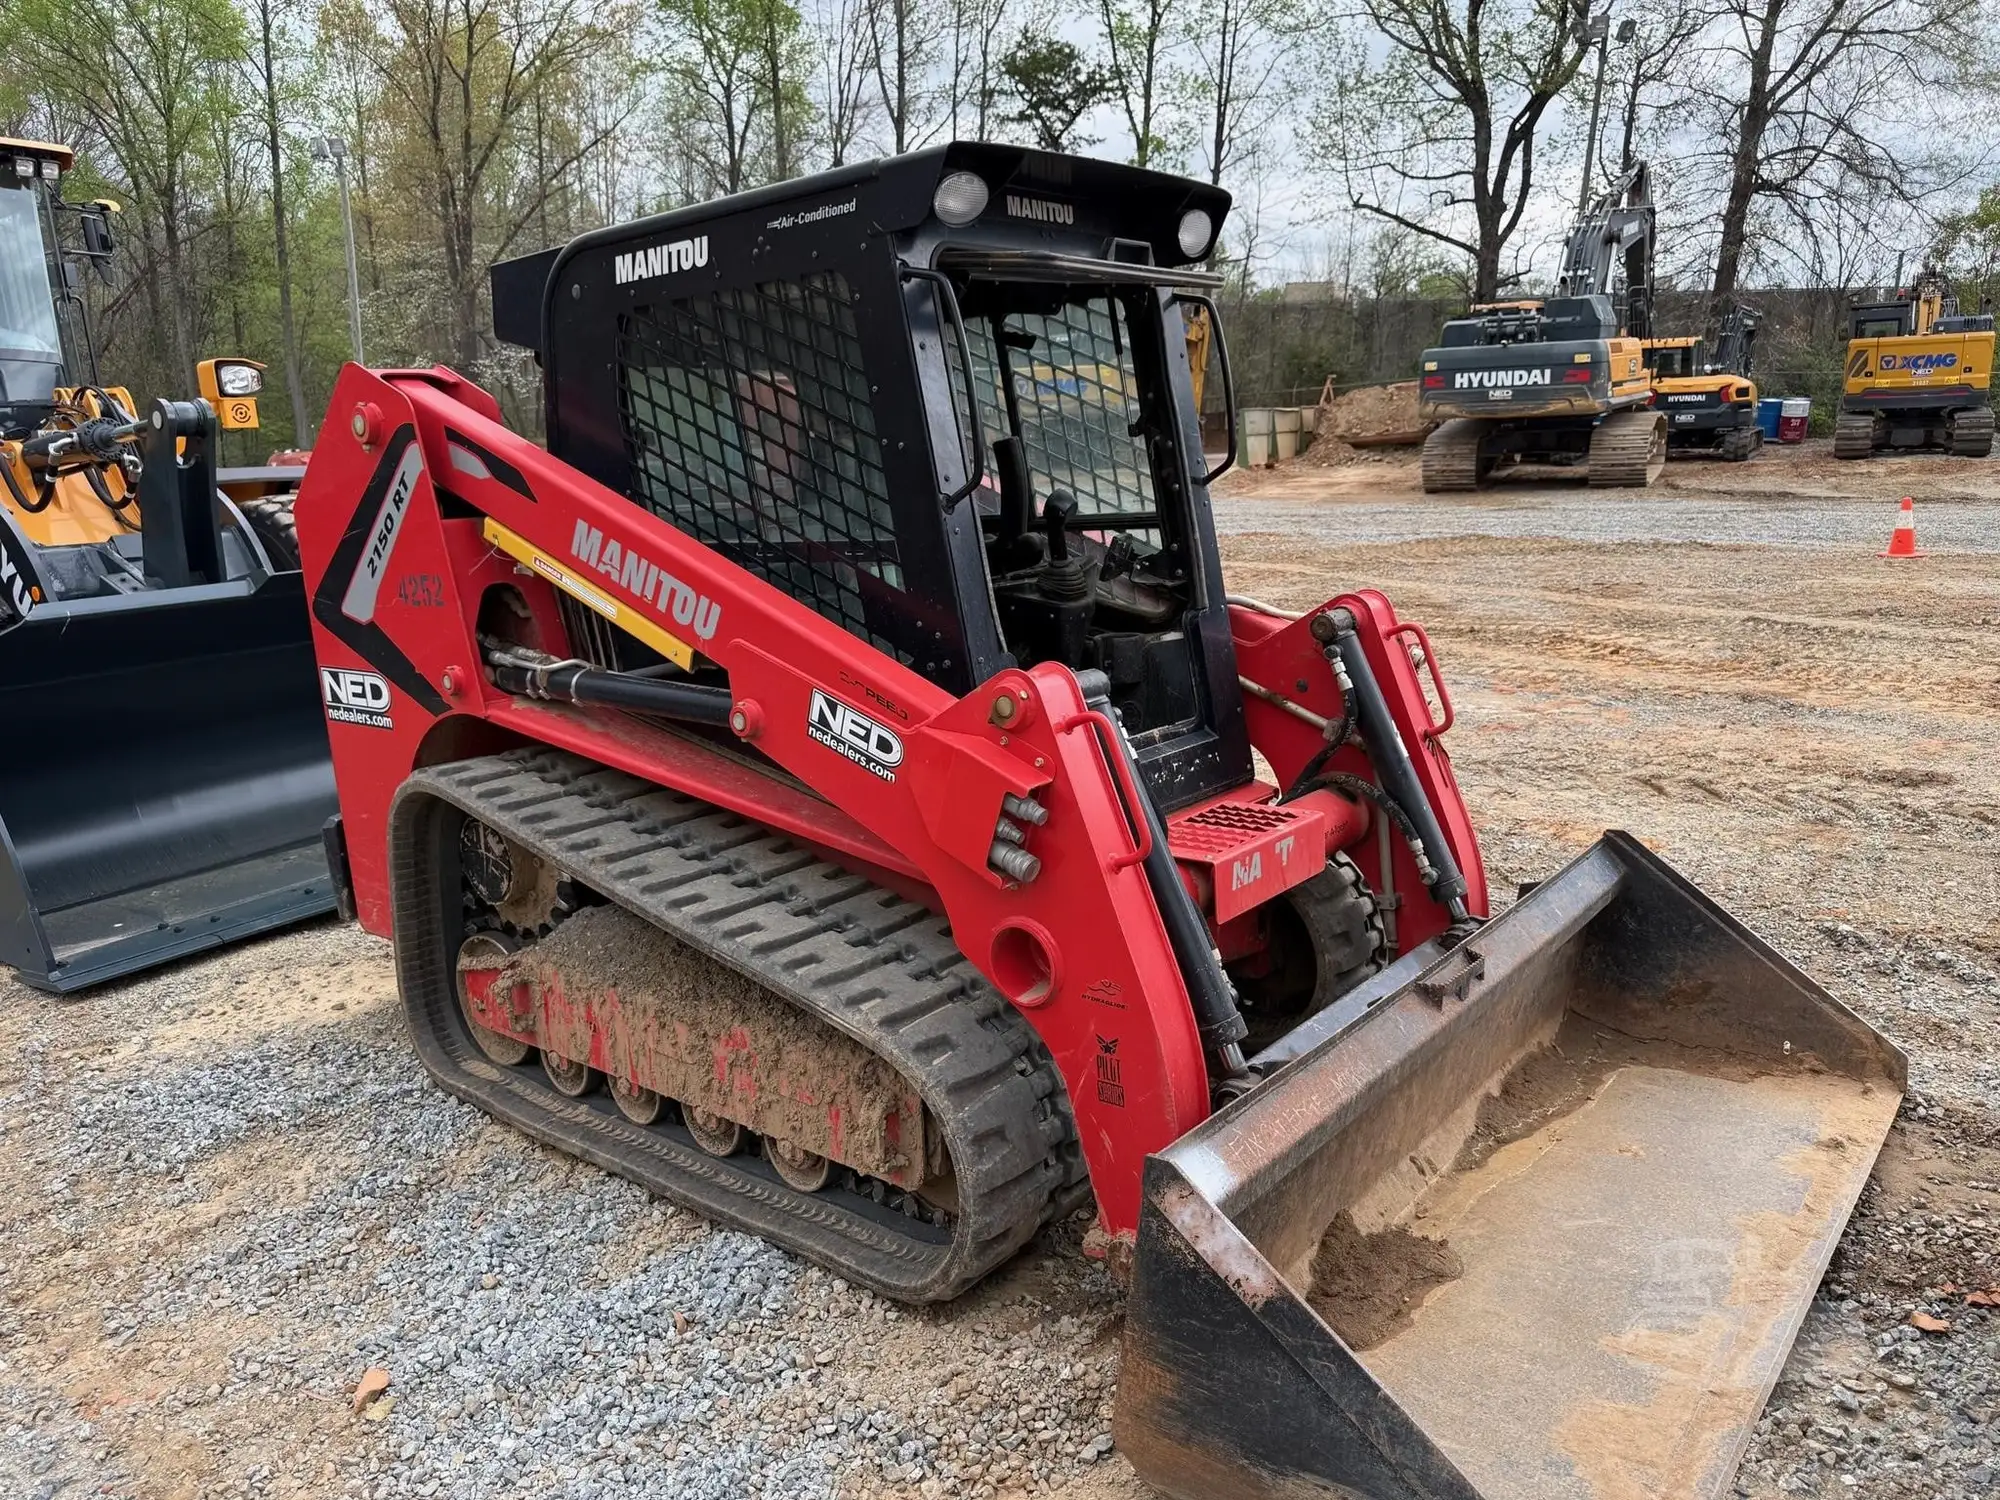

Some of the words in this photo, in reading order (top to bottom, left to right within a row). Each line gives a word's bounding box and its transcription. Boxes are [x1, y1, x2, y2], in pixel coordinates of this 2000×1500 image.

[781, 198, 857, 229] Air-Conditioned
[1006, 195, 1073, 225] MANITOU
[615, 235, 709, 284] MANITOU
[1454, 369, 1551, 388] HYUNDAI
[1900, 353, 1958, 369] XCMG
[366, 512, 394, 578] 2150
[391, 472, 410, 512] RT
[399, 574, 445, 607] 4252
[571, 518, 722, 640] MANITOU
[322, 671, 389, 709] NED
[328, 708, 393, 729] nedealers.com
[811, 692, 901, 763] NED
[808, 726, 896, 784] nedealers.com
